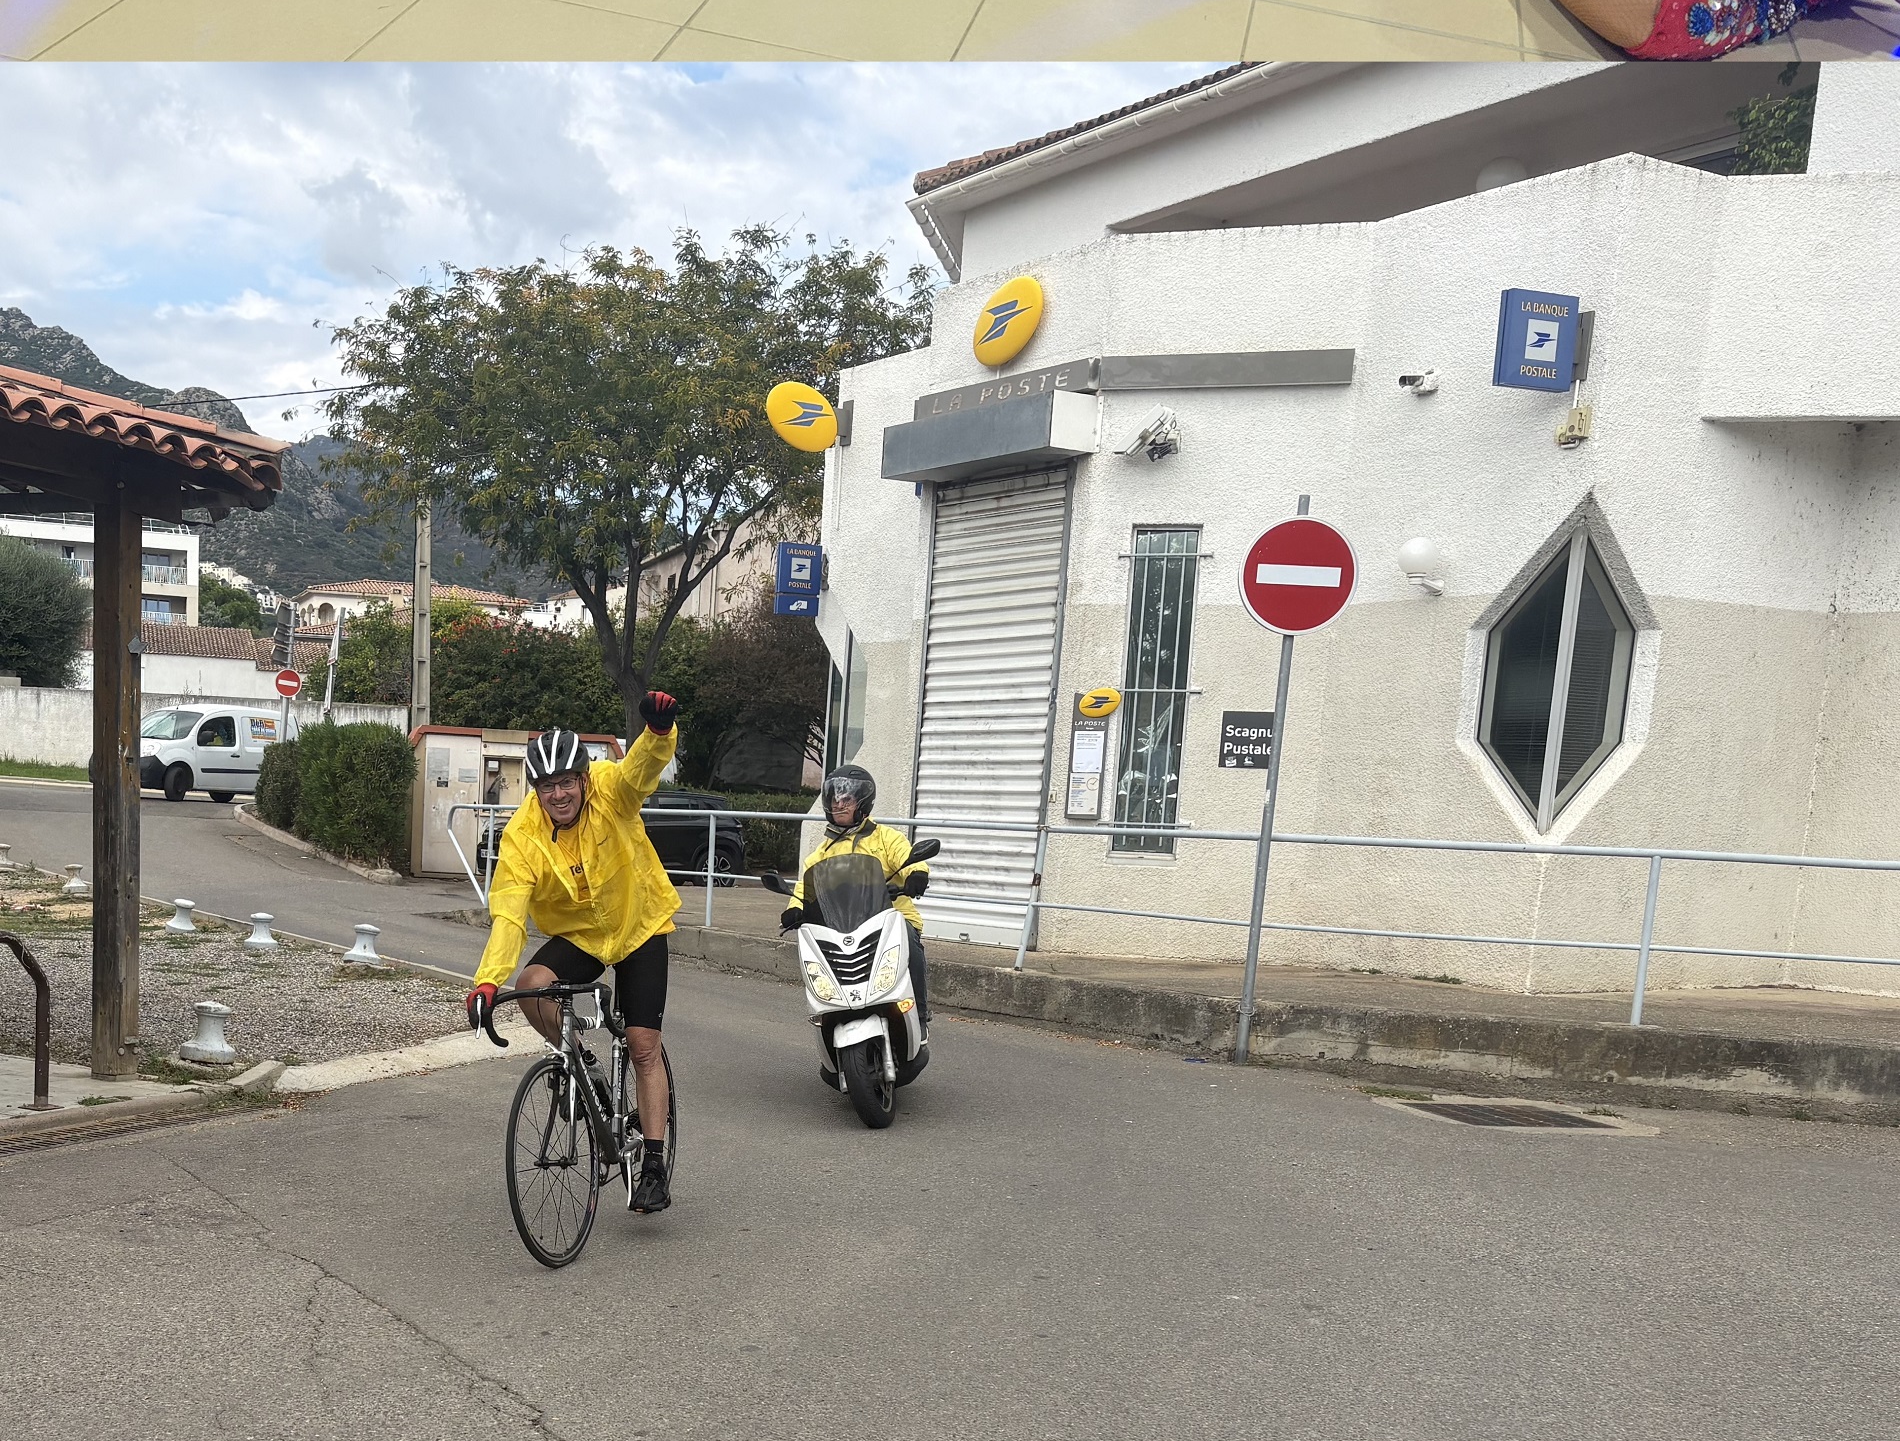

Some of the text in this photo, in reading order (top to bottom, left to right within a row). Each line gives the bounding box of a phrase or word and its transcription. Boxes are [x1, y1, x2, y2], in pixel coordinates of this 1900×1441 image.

[1521, 301, 1569, 318] LA BANQUE
[1520, 364, 1557, 379] POSTALE
[932, 368, 1071, 415] LA POSTE
[788, 581, 812, 590] POSTALE
[1084, 720, 1106, 728] POSTE
